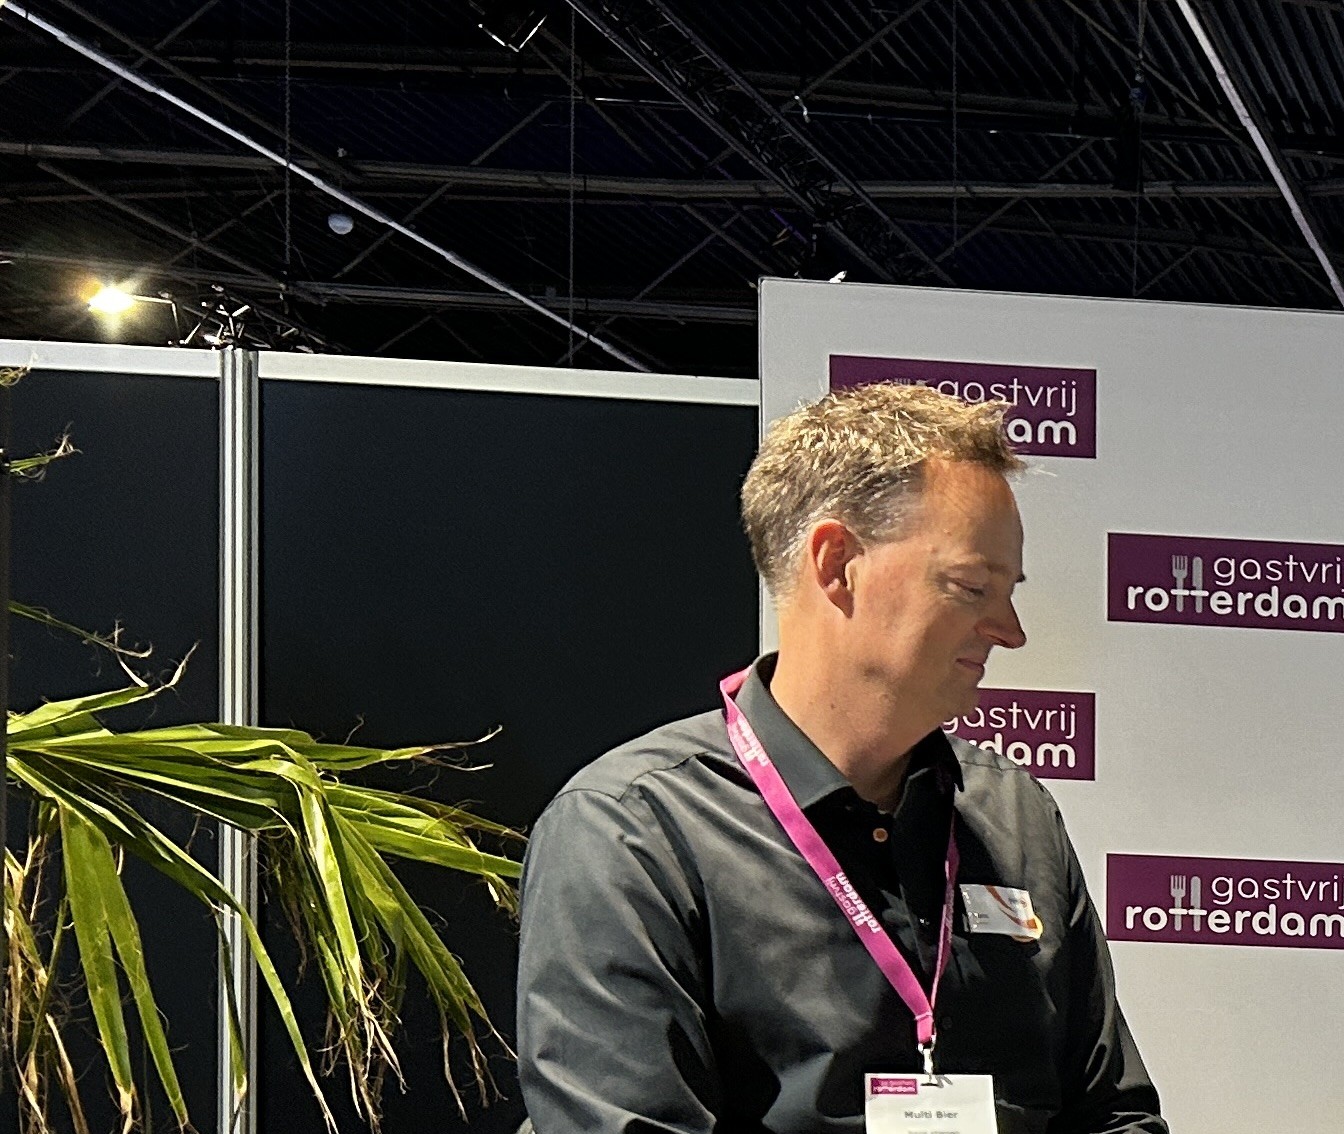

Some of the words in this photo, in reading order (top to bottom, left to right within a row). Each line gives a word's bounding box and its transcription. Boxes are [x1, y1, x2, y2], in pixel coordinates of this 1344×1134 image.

[836, 872, 881, 933] rotterdam
[904, 1110, 932, 1119] Multi
[936, 1110, 958, 1119] Bier
